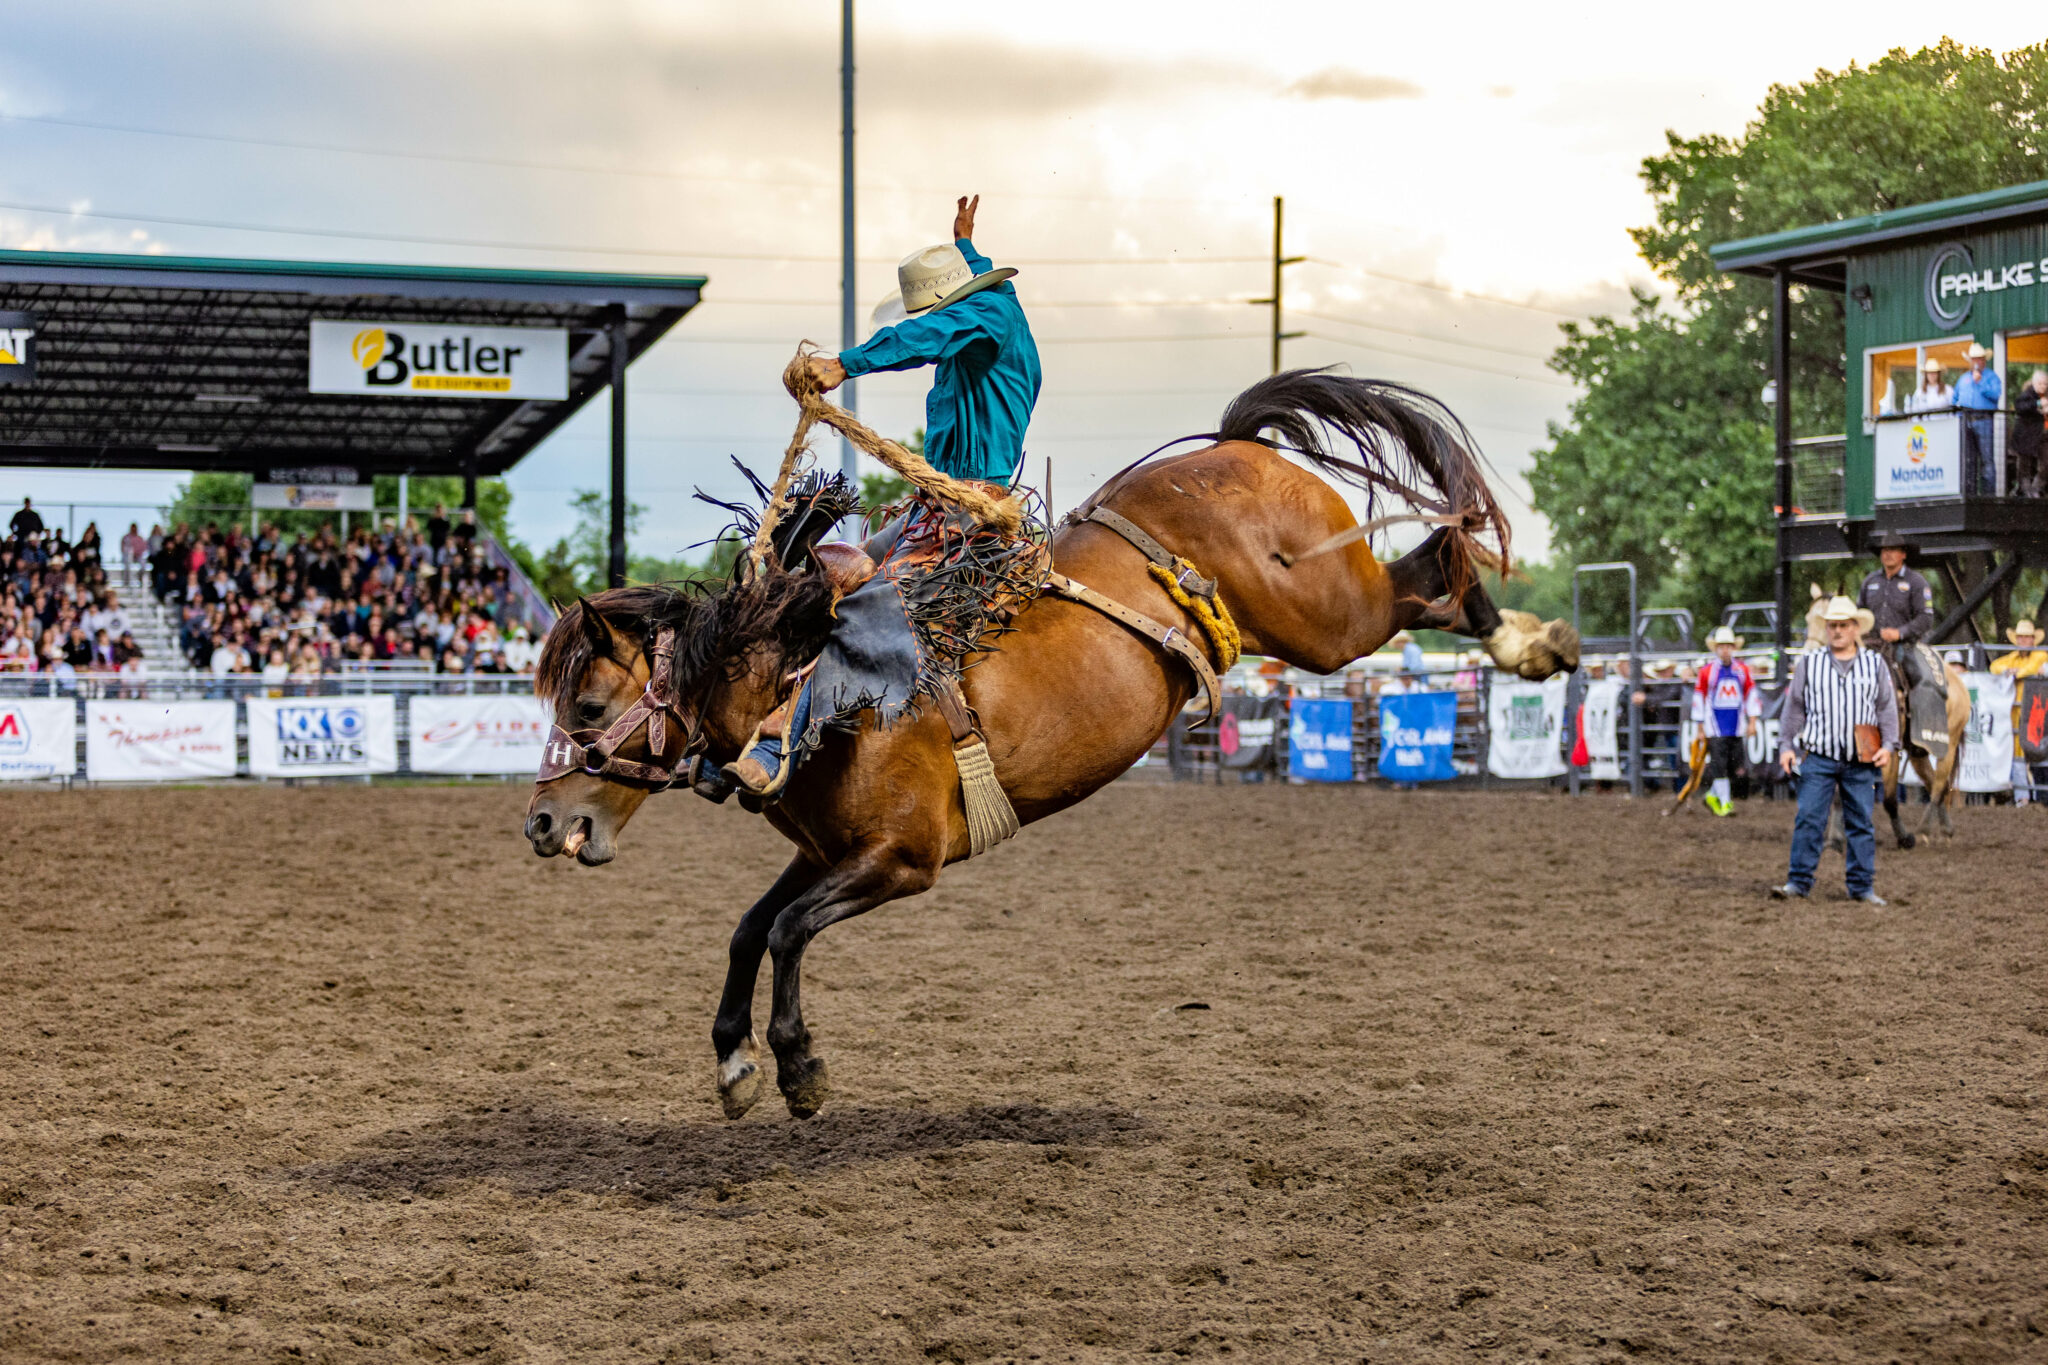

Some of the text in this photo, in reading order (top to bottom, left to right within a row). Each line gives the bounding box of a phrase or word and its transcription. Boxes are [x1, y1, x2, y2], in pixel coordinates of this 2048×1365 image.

[1940, 261, 2035, 299] PAHLKE
[366, 332, 524, 387] Butler
[1891, 463, 1944, 483] Mandan
[283, 743, 363, 759] NEWS
